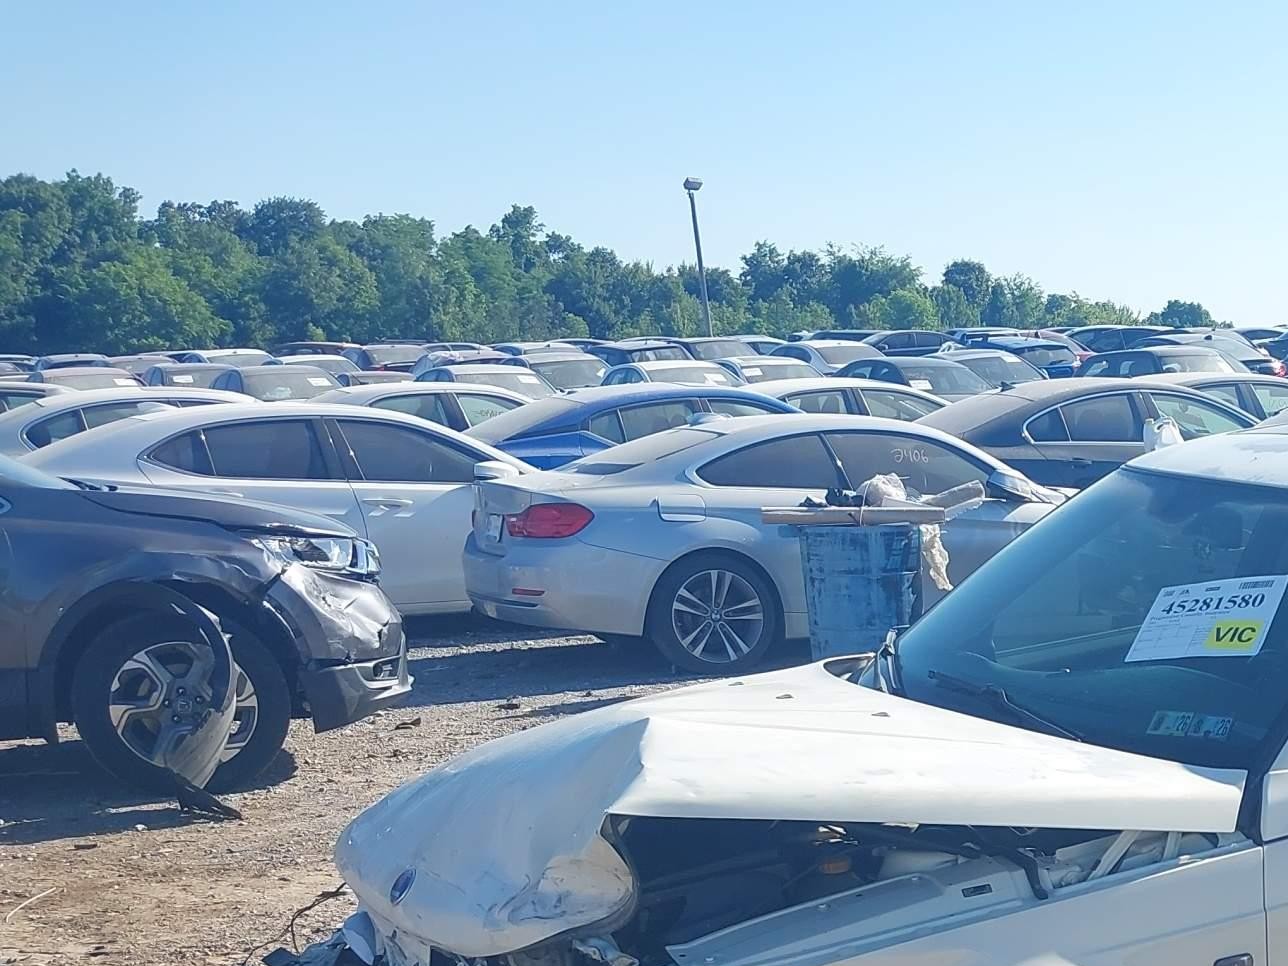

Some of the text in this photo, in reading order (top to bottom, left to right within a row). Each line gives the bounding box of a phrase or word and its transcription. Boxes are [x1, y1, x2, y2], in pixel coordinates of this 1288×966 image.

[890, 448, 929, 463] 2406
[1161, 593, 1266, 615] 45281580
[1215, 626, 1256, 643] VIC
